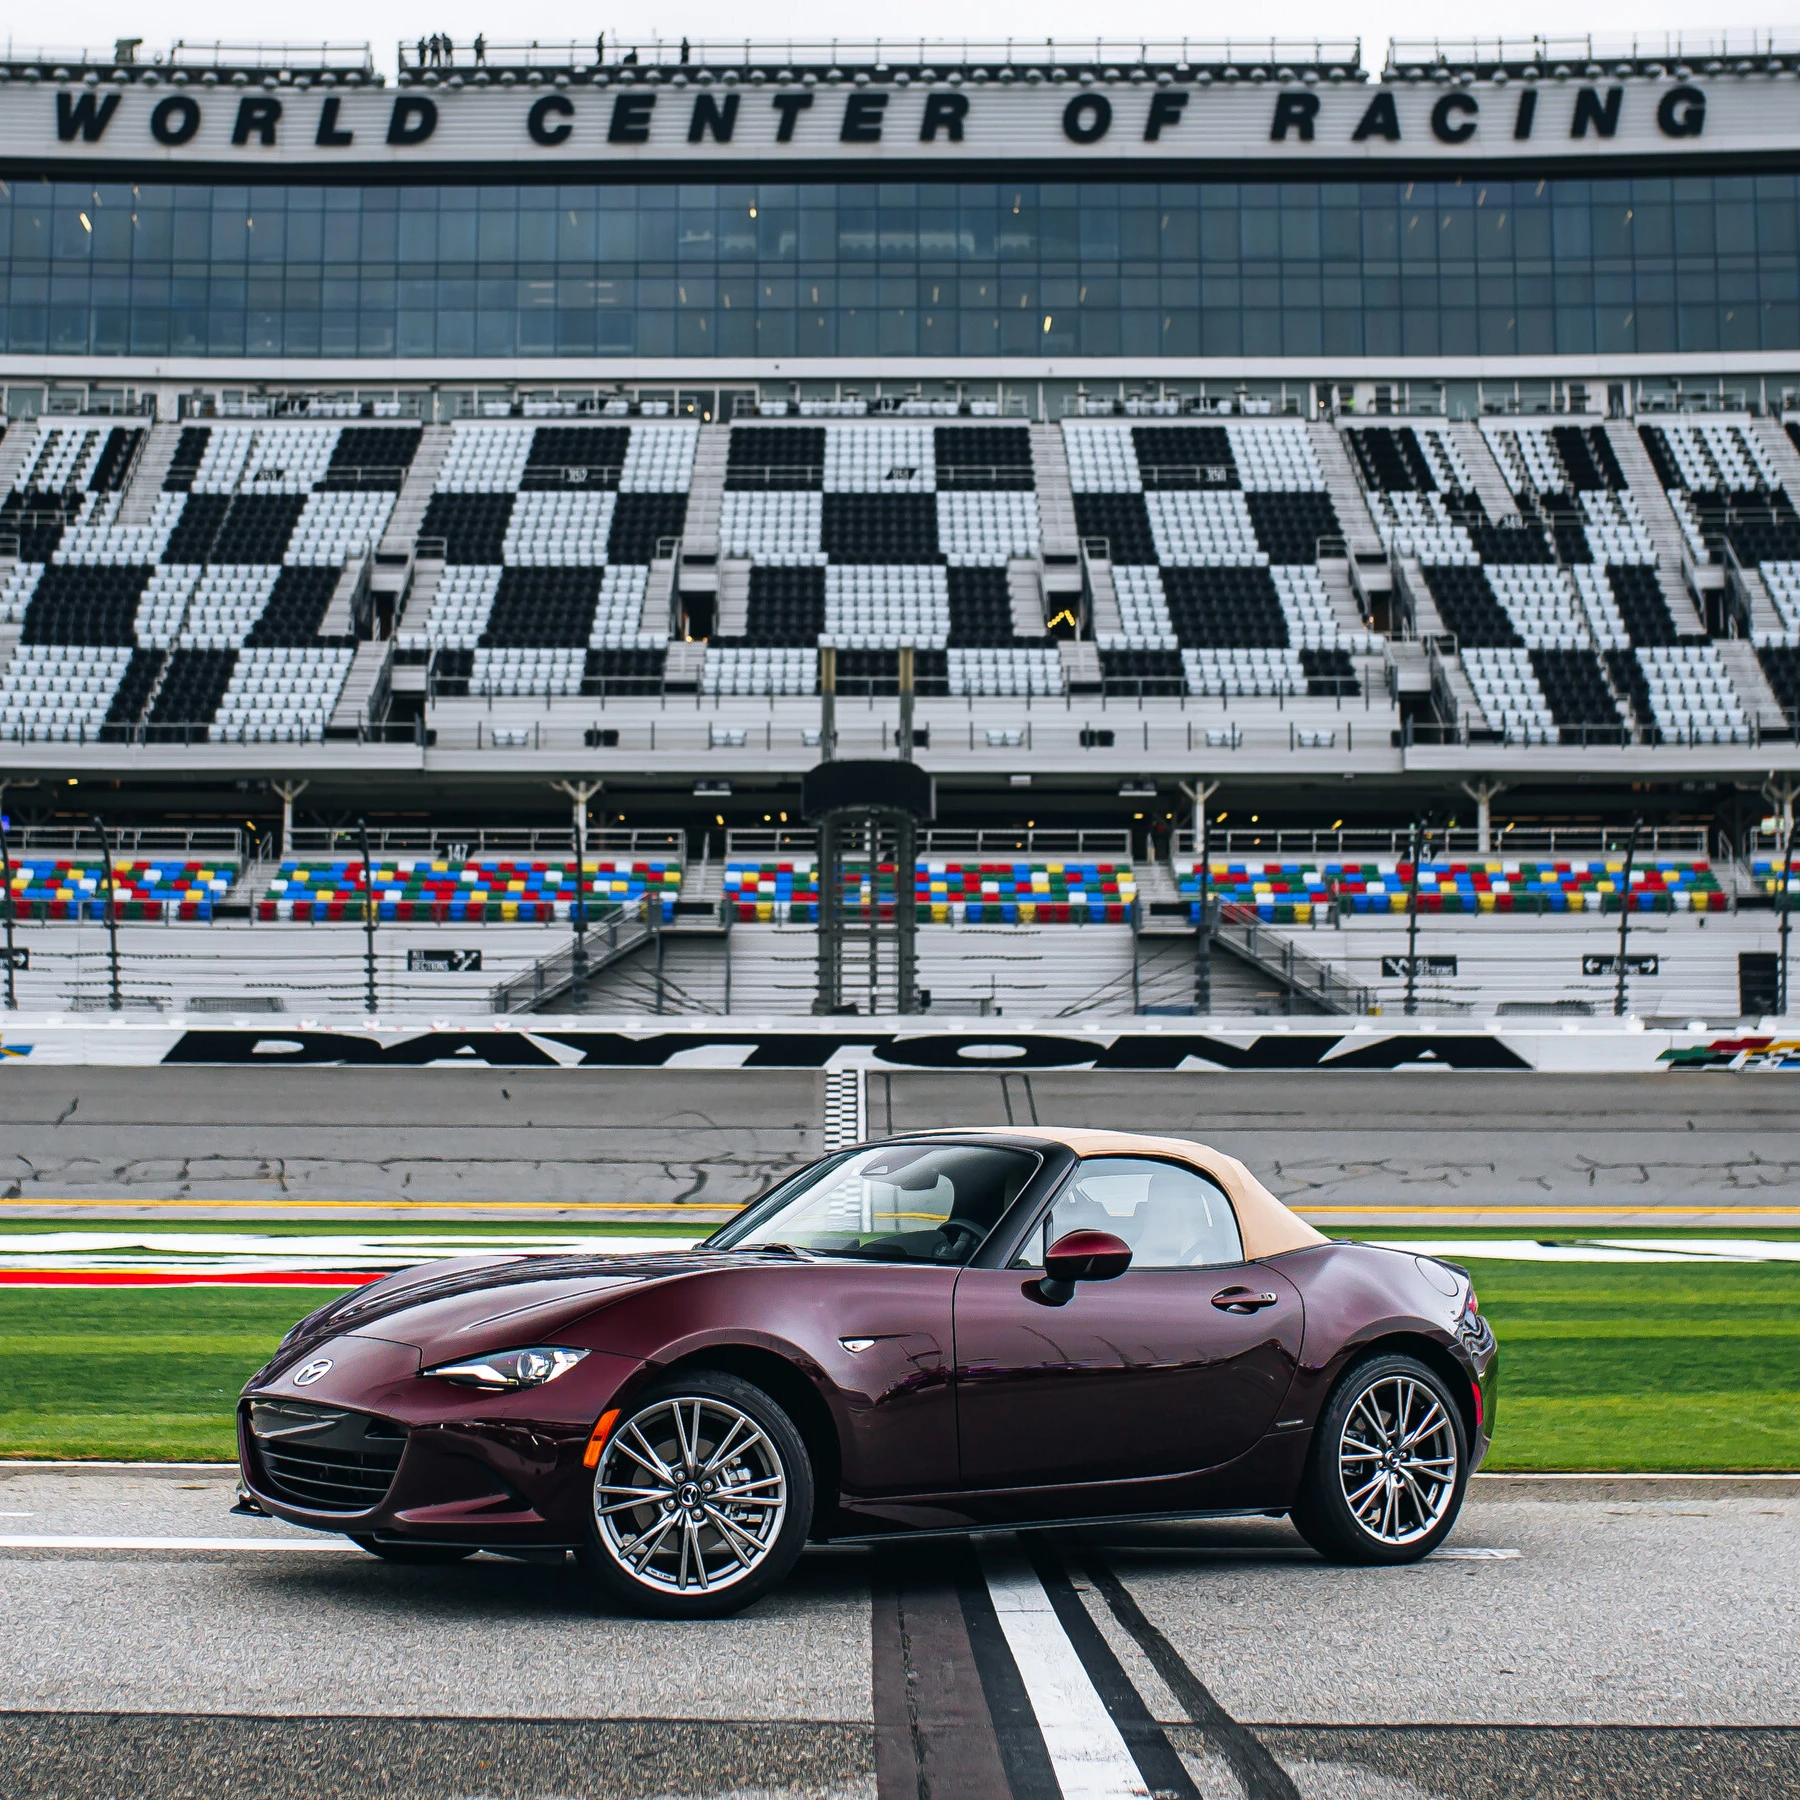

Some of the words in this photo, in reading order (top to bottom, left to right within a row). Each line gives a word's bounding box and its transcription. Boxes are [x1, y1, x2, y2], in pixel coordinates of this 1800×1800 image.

[56, 91, 440, 147] WORLD
[527, 91, 970, 147] CENTER
[1062, 91, 1189, 144] OF
[1270, 83, 1707, 144] RACING
[447, 844, 468, 861] 147
[161, 1030, 1534, 1072] DAYTONA
